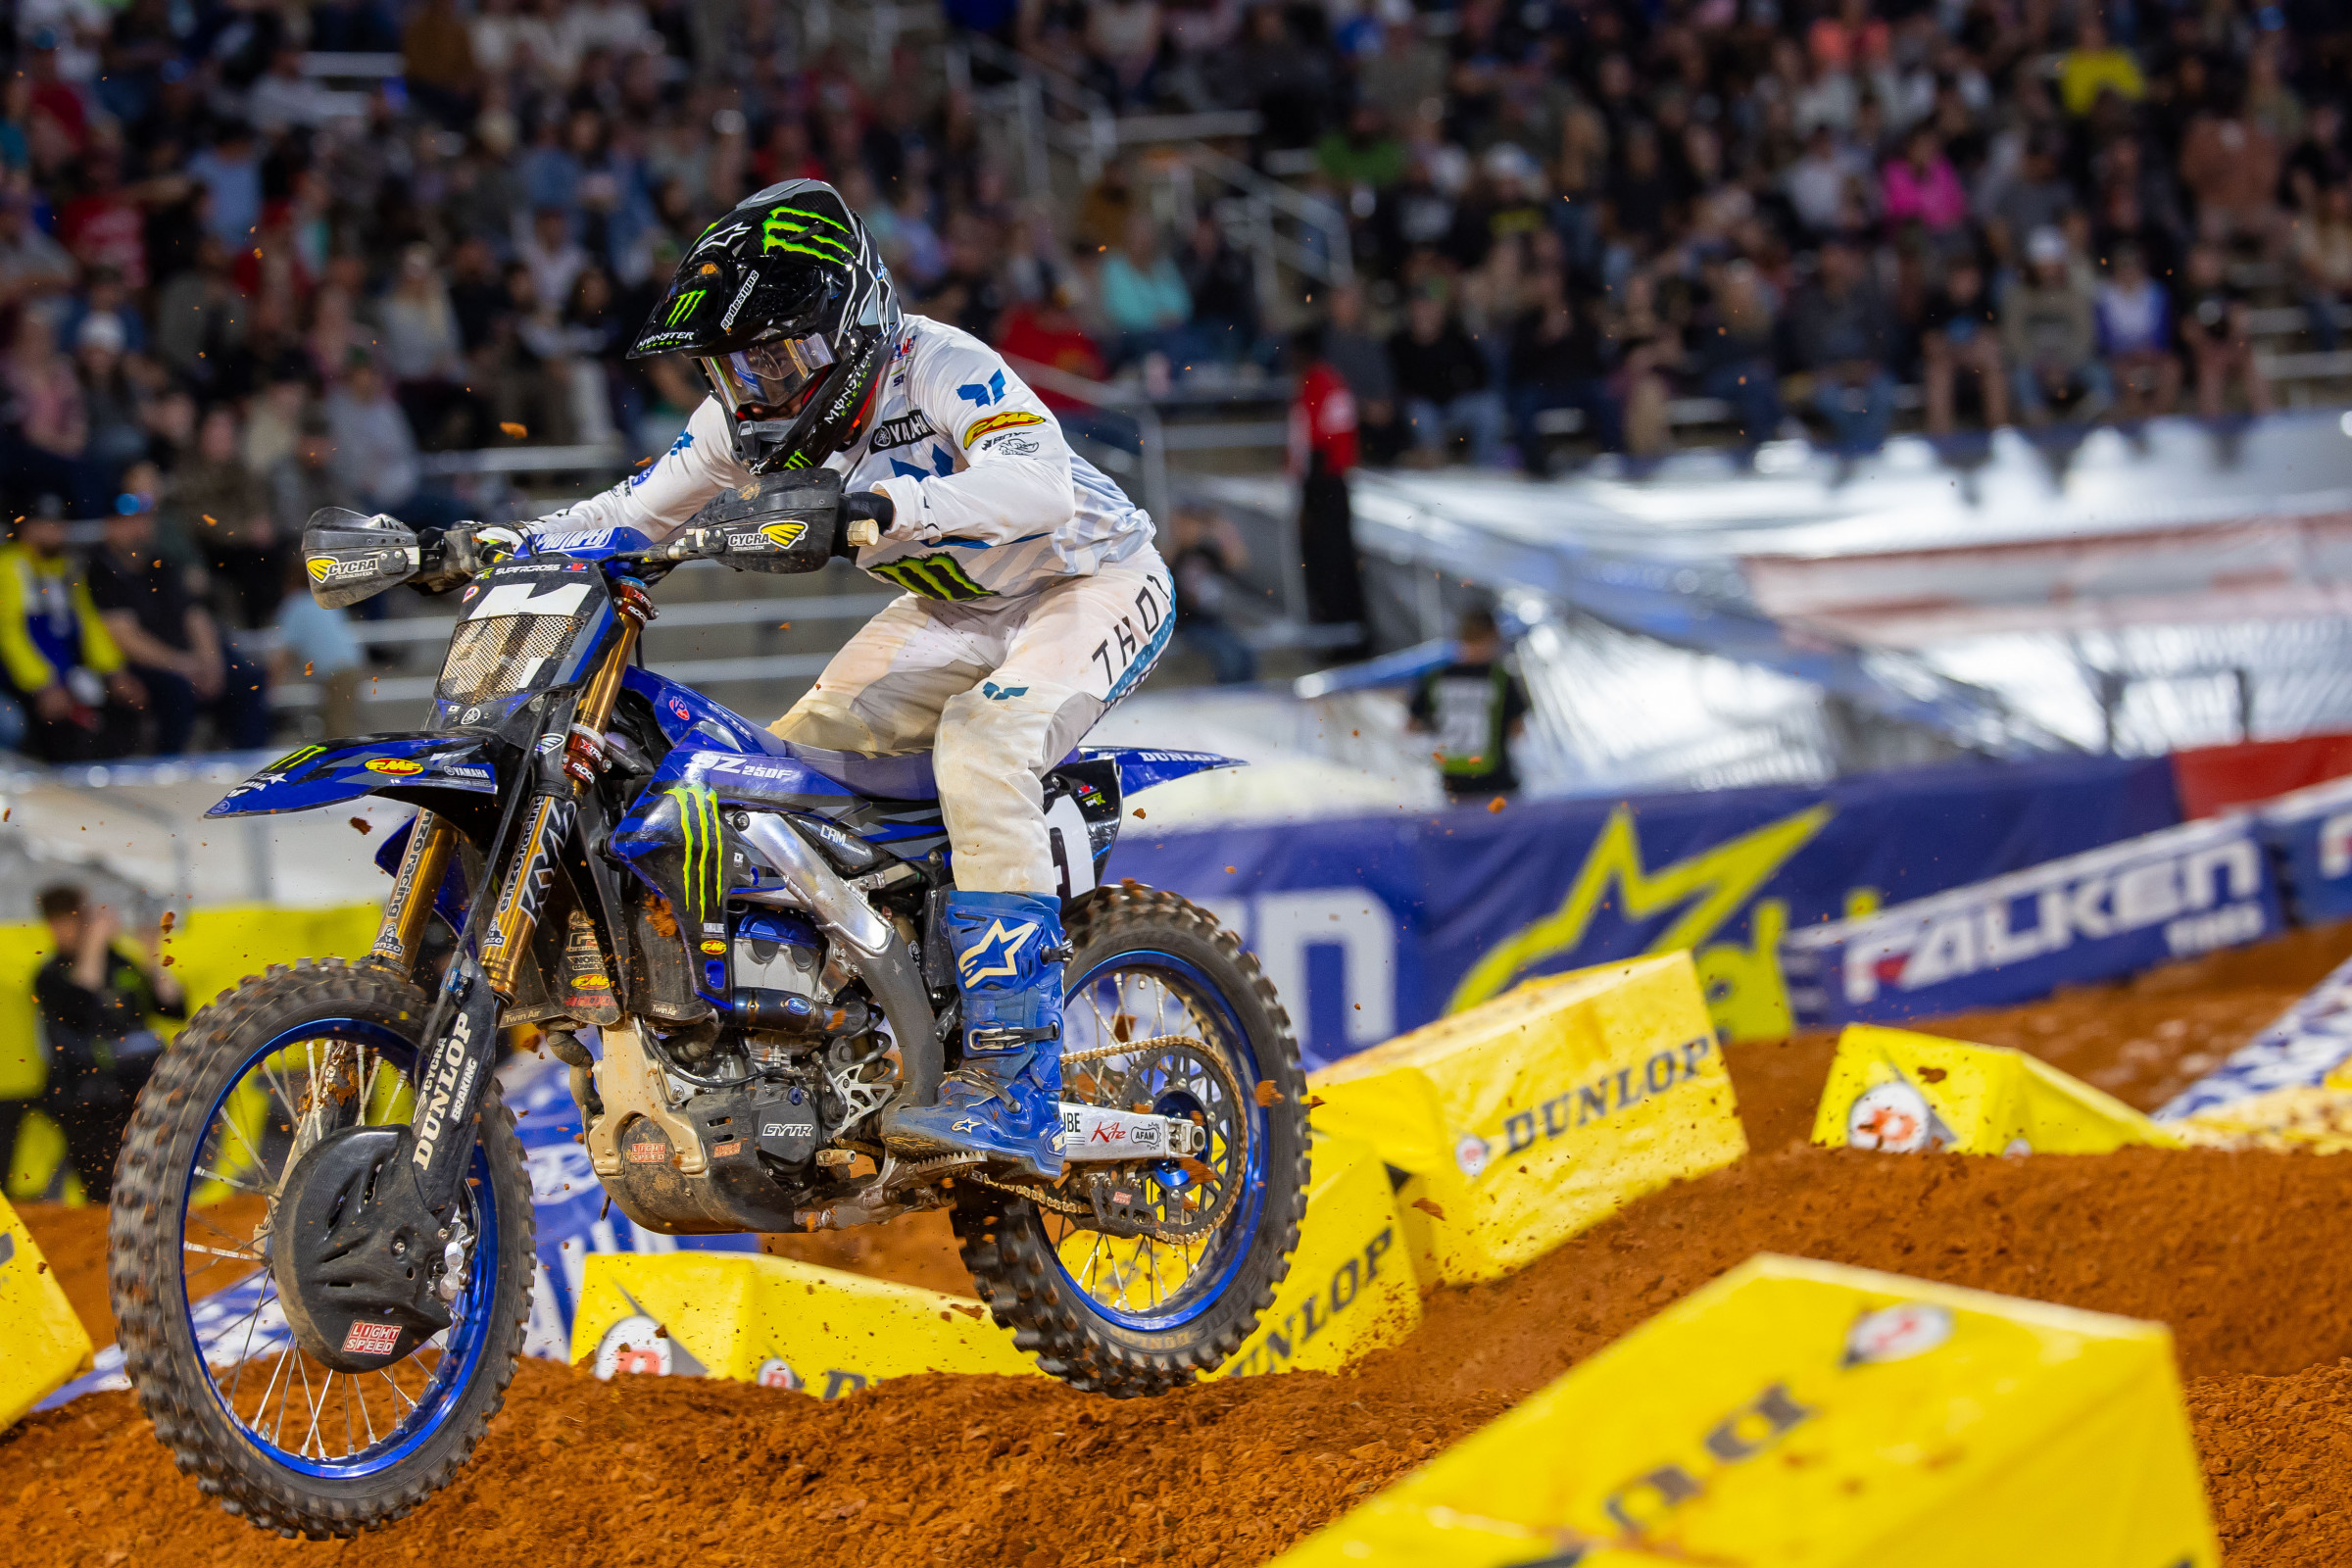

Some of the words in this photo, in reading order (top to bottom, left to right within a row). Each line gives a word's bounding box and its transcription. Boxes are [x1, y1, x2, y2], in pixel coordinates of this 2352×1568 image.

[636, 331, 695, 349] MONSTER
[728, 534, 769, 546] CYCRA
[327, 558, 377, 576] CYCRA
[495, 564, 561, 575] SUPERCROSS
[454, 767, 490, 779] YAMAHA
[423, 1038, 447, 1092] CYCRA
[413, 1012, 470, 1171] DUNLOP
[450, 1056, 478, 1123] BRAKING
[1501, 1036, 1709, 1158] DUNLOP
[762, 1124, 813, 1137] GYTR
[1091, 1121, 1126, 1143] Kite
[1135, 1131, 1154, 1140] AFAM
[353, 1324, 400, 1339] LIGHT
[347, 1339, 393, 1351] SPEED
